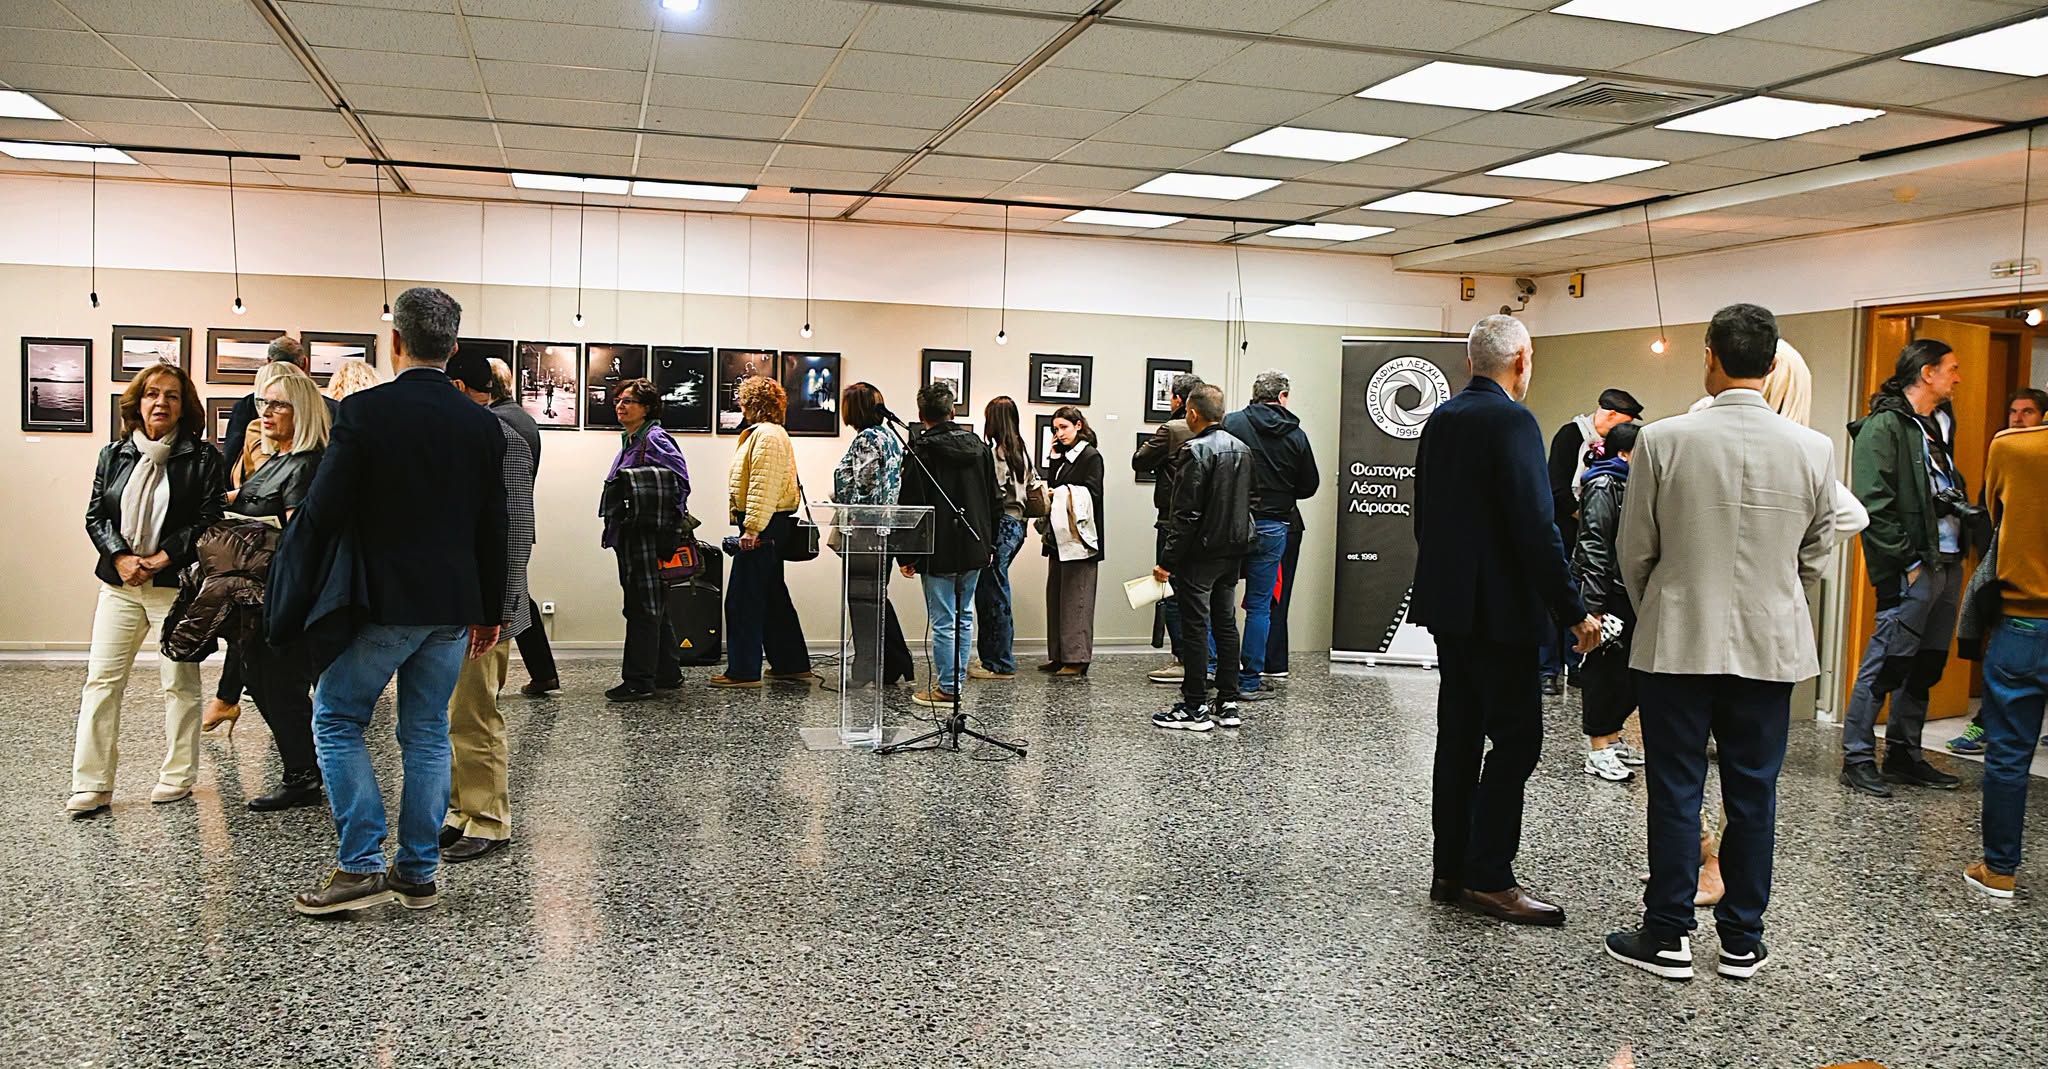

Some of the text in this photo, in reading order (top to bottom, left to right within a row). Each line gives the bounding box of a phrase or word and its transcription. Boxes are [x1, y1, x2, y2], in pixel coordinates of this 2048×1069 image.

[1407, 361, 1441, 380] ΛΕΣΧΗ
[1436, 382, 1449, 404] ΛΑΡ
[1396, 428, 1419, 437] 1996
[1349, 480, 1397, 498] Λέσχη
[1348, 499, 1411, 516] Λάρισας
